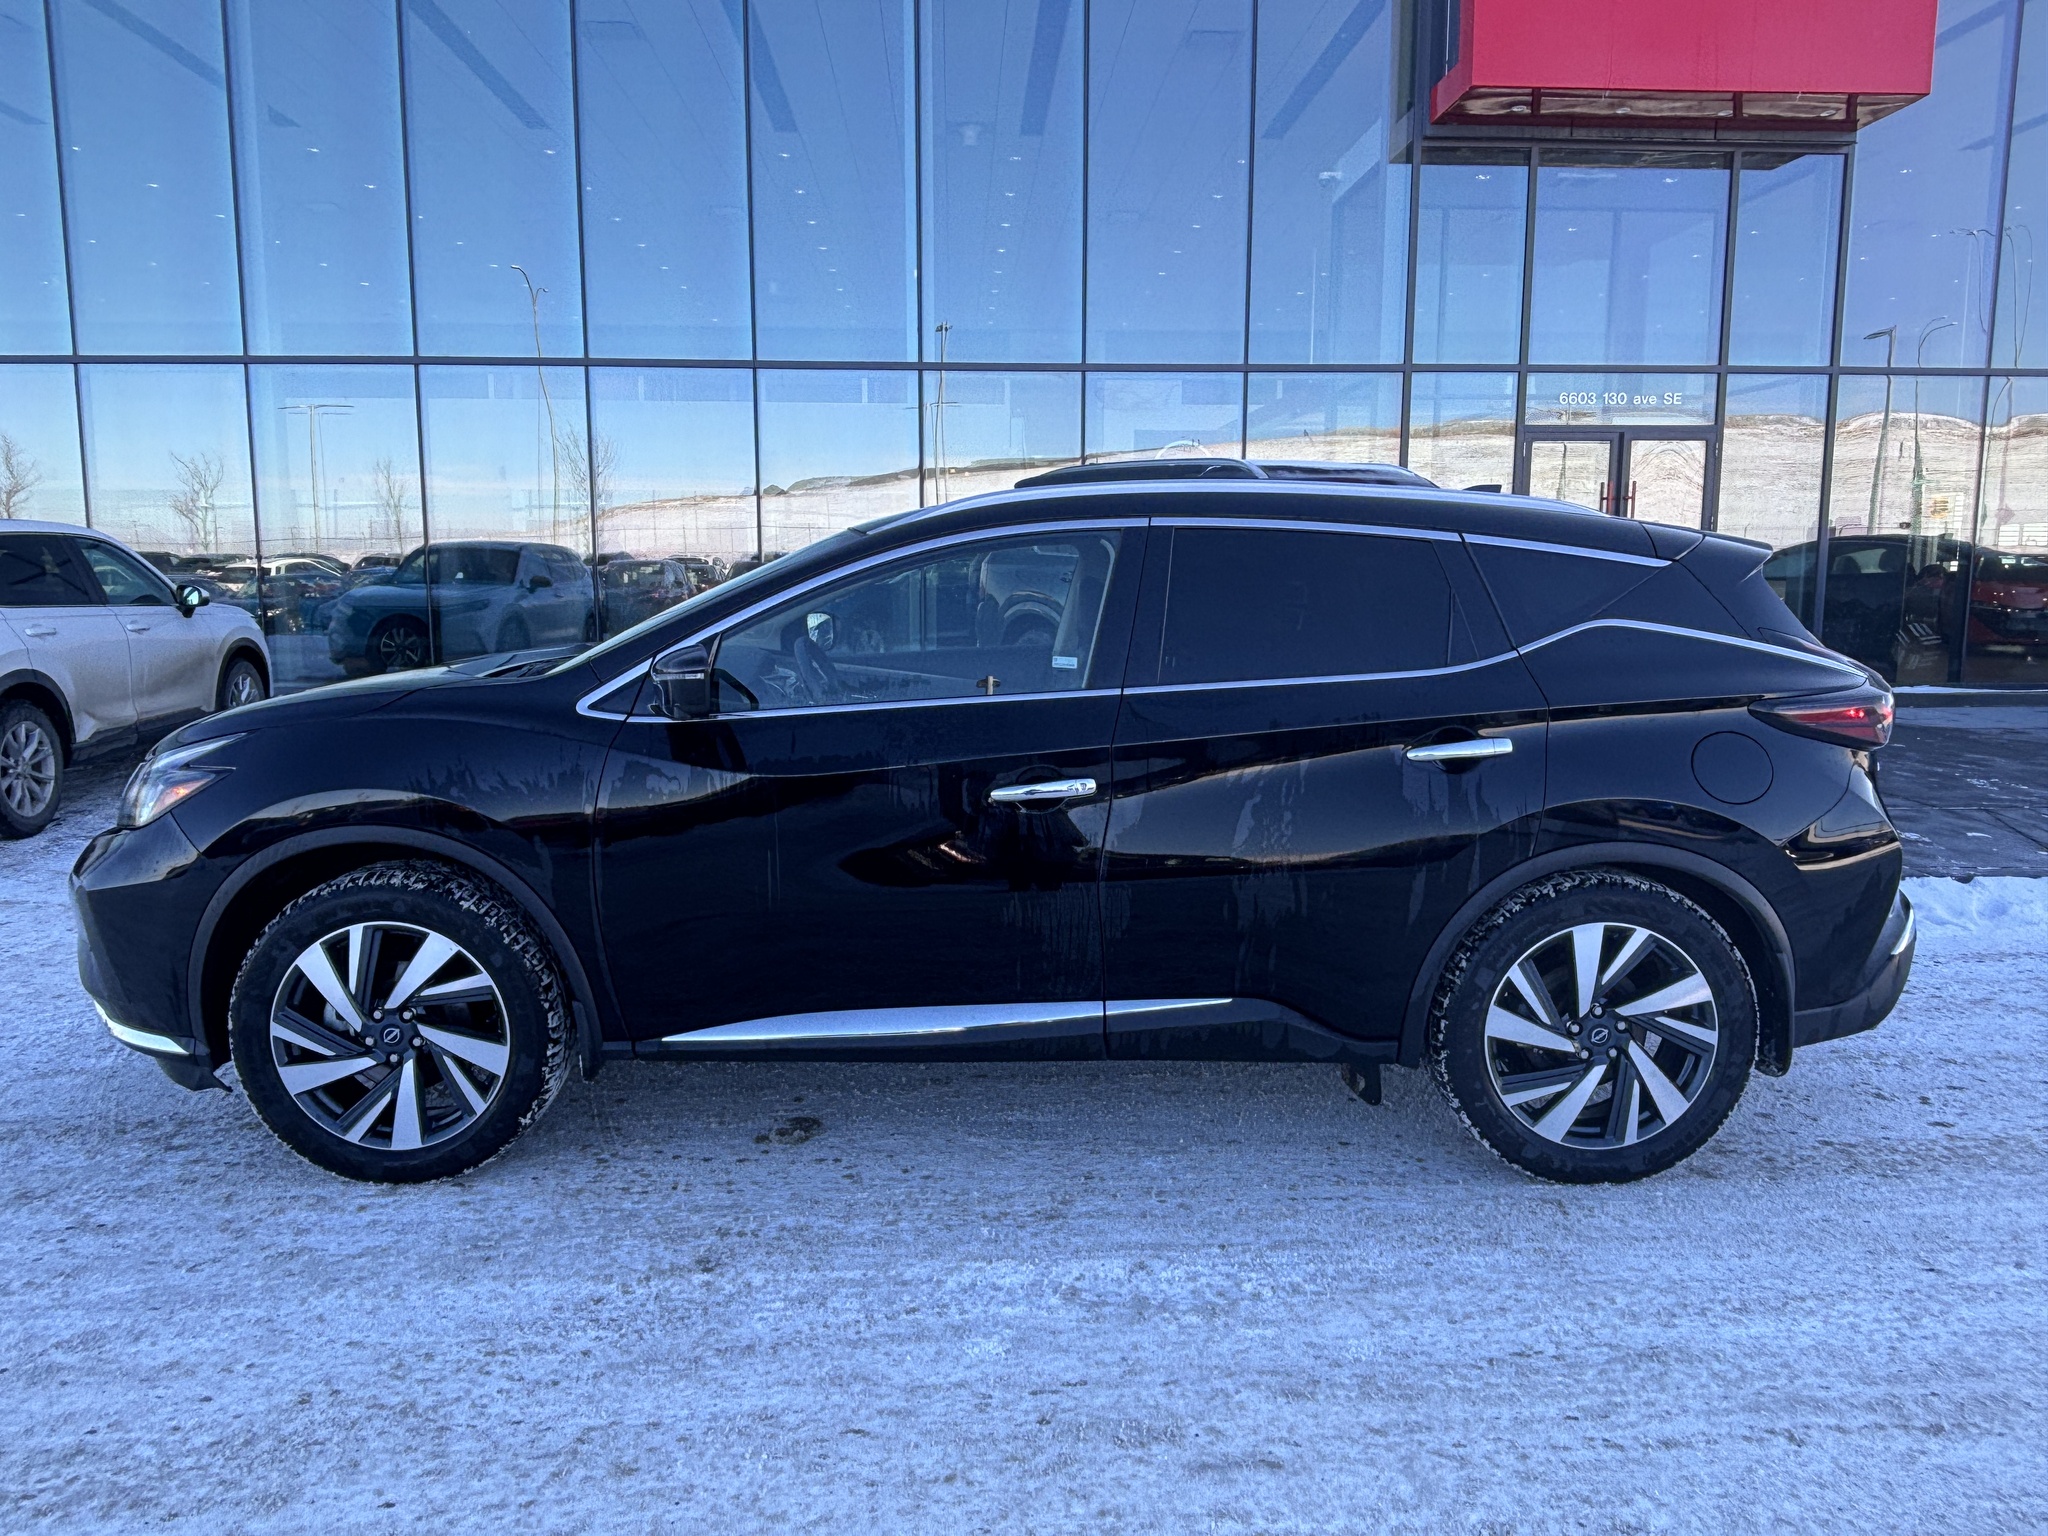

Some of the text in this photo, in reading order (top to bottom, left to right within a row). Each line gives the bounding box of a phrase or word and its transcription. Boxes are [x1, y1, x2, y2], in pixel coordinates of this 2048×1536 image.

[1559, 392, 1683, 405] 6603 130 ave SE
